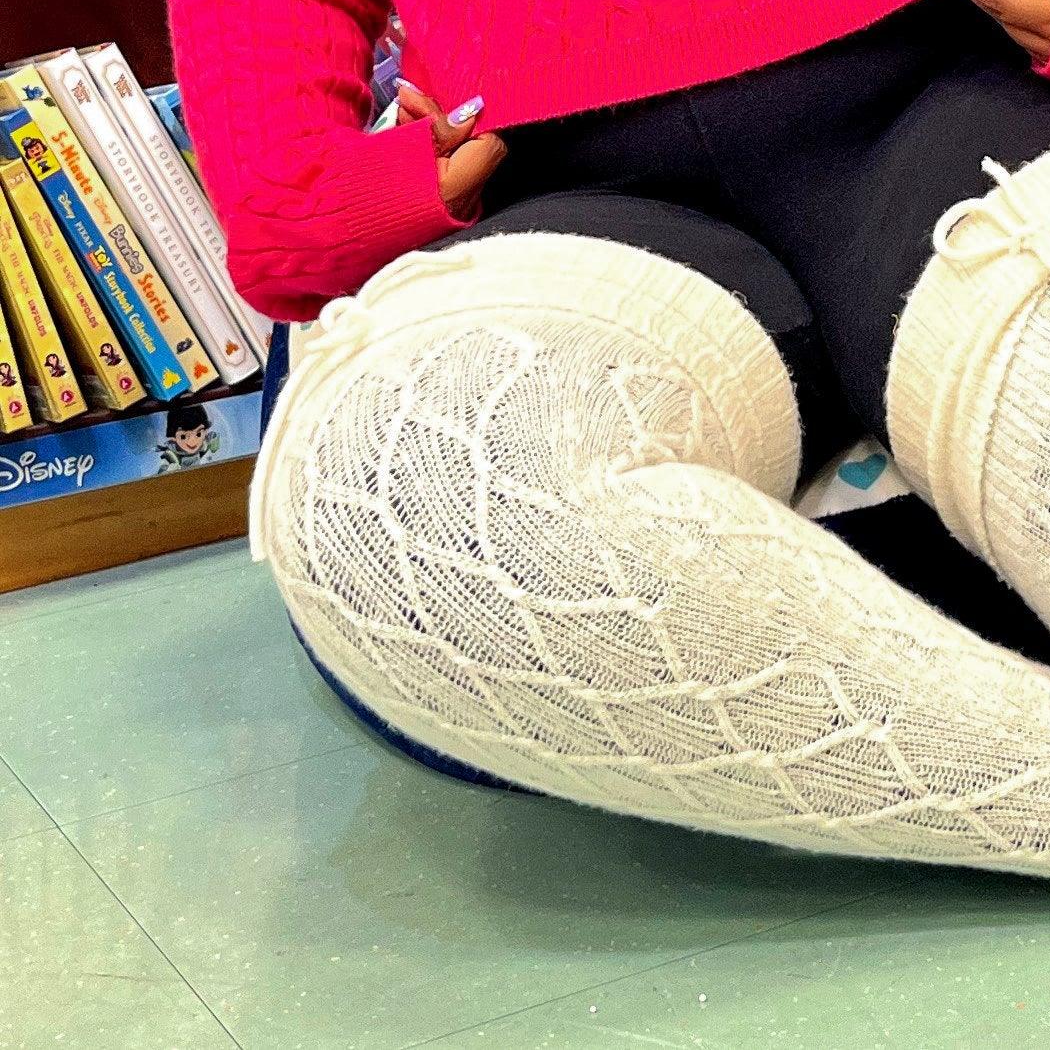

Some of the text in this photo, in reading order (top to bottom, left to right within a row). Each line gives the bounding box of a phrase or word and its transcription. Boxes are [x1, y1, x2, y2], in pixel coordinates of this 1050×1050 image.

[50, 129, 99, 196] 5-Minute
[106, 222, 148, 276] Bunnies
[135, 271, 176, 324] Stories
[106, 139, 160, 223] STORYBOOK
[156, 225, 203, 296] TREASURY
[148, 133, 201, 215] STORYBOOK
[53, 190, 158, 354] Disney PIXAR TOY Storybook Collection
